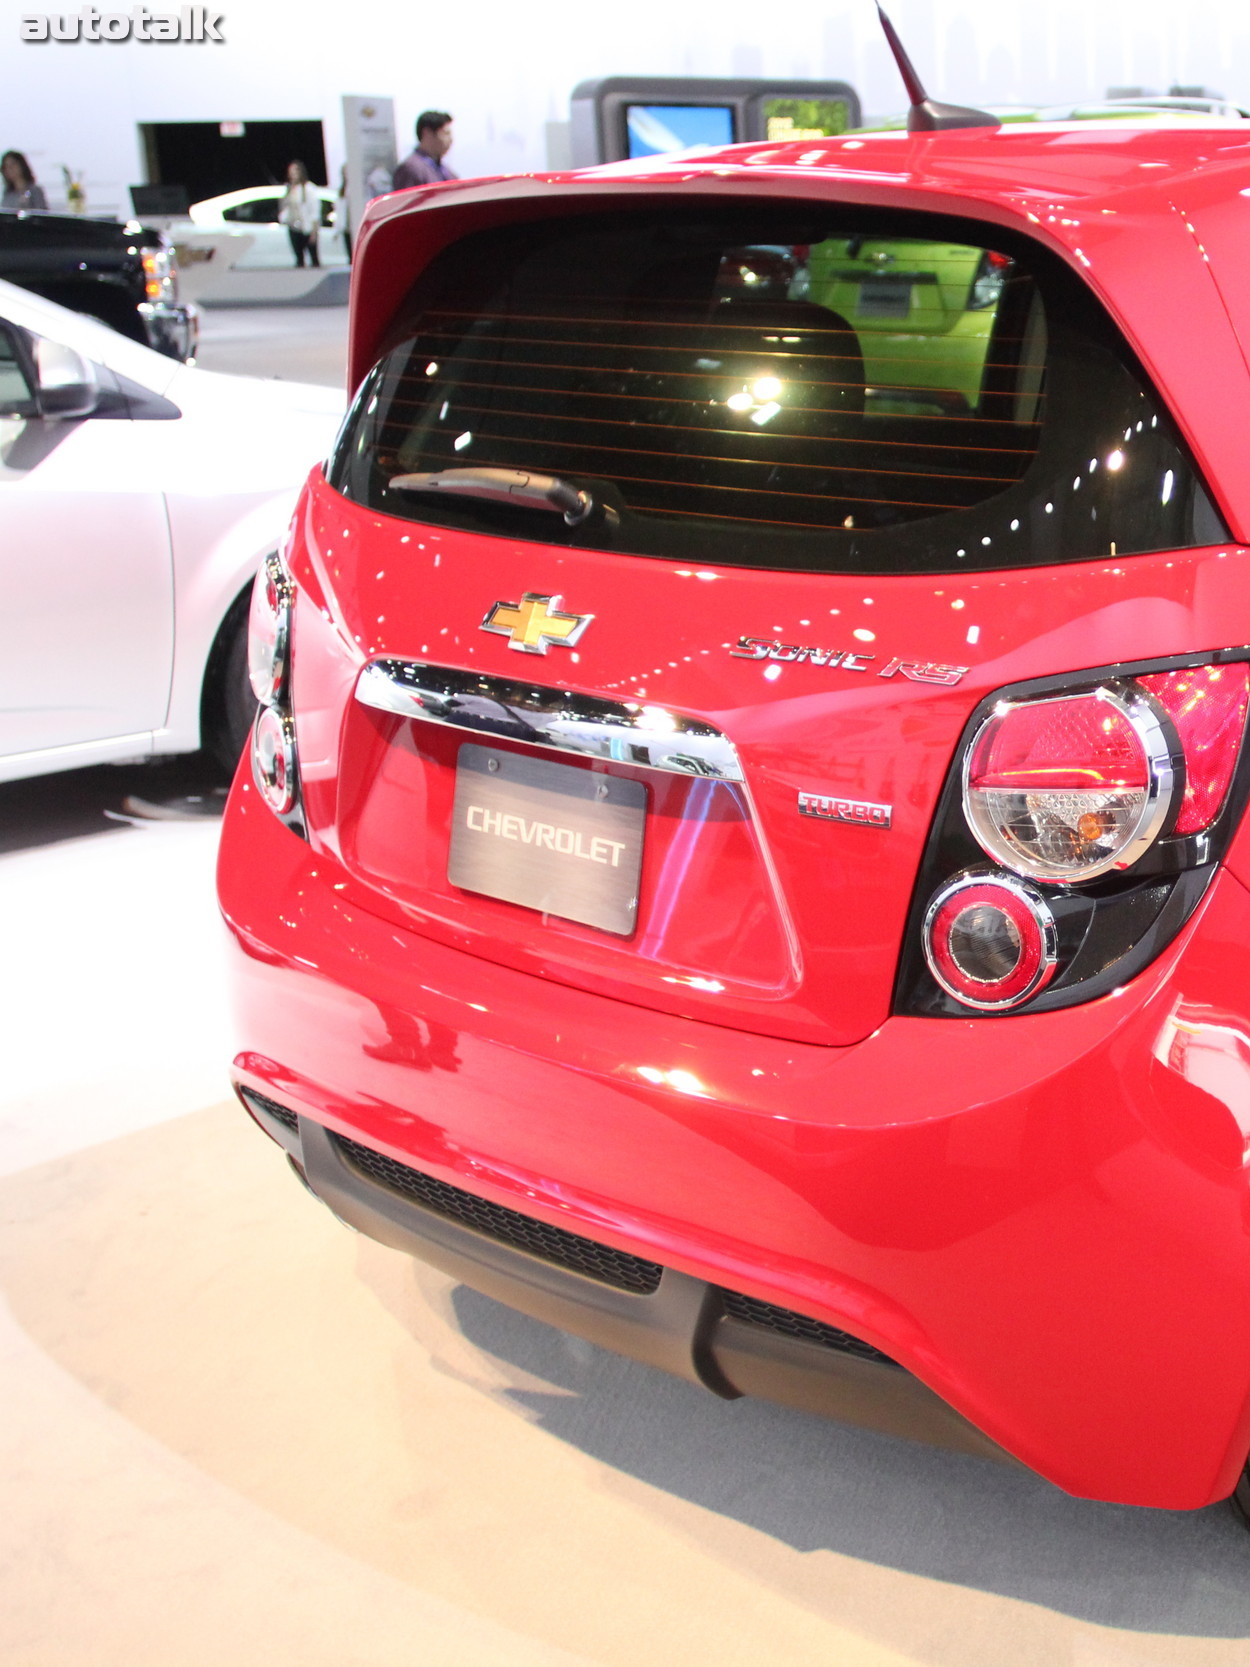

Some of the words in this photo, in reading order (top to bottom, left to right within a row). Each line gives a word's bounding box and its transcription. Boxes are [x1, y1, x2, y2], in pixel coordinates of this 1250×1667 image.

[877, 657, 969, 686] RS
[803, 796, 888, 825] TURBO
[467, 805, 626, 868] CHEVROLET
